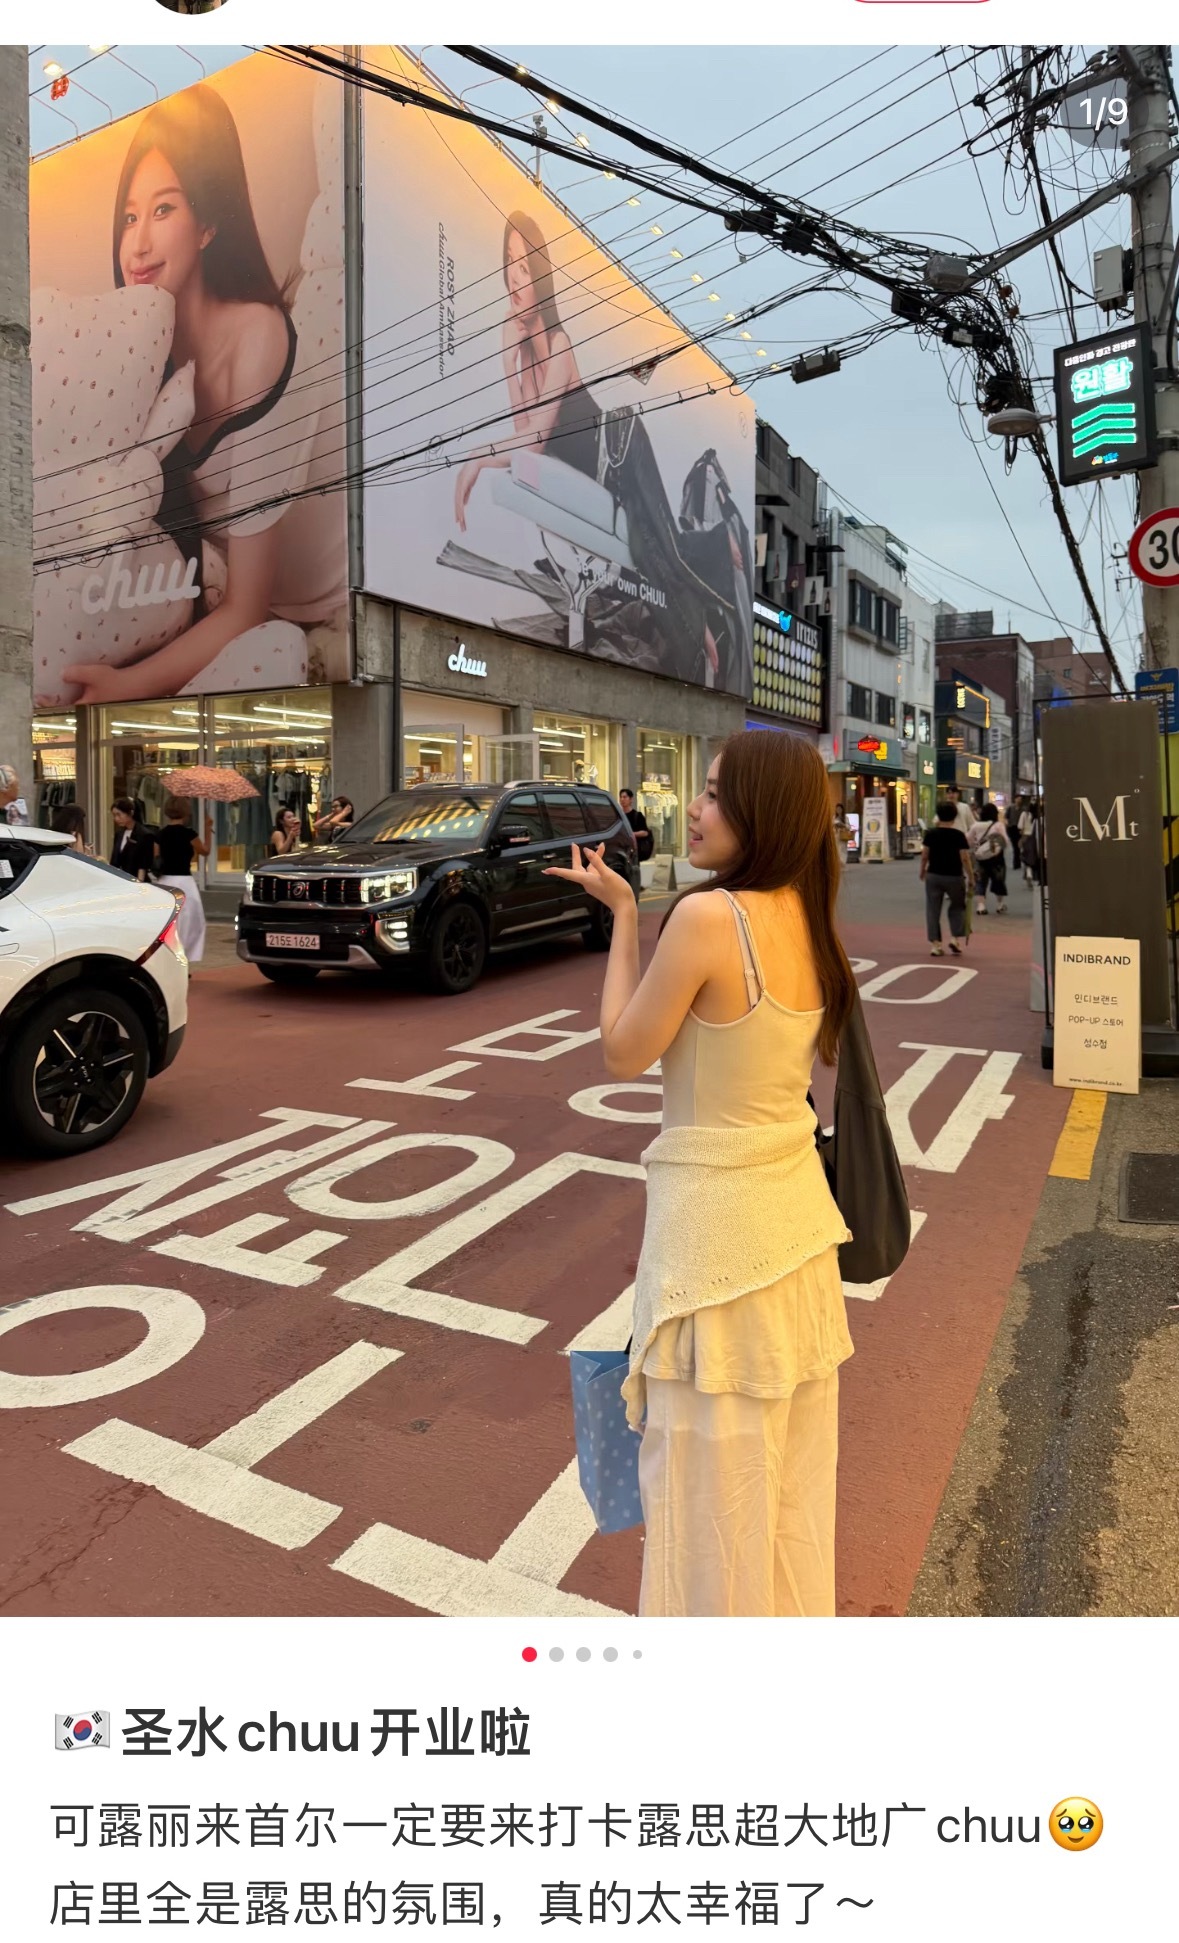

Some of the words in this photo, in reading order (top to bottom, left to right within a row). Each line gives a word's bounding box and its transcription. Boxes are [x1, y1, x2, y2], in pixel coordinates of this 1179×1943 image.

[438, 222, 447, 259] chuu
[446, 256, 455, 304] ROSY
[438, 301, 446, 378] Ambassador
[446, 306, 455, 356] ZHAO
[1071, 357, 1134, 403] 원활
[81, 543, 201, 615] chuu
[617, 577, 637, 597] own
[639, 583, 667, 609] CHUU.
[447, 643, 488, 677] chuu
[293, 936, 317, 948] 1624
[1063, 953, 1131, 966] INDIBRAND
[1074, 994, 1119, 1005] 인디브랜드
[1068, 1015, 1101, 1025] POP-UP
[1102, 1018, 1124, 1027] 스토어
[1083, 1038, 1108, 1050] 성수점
